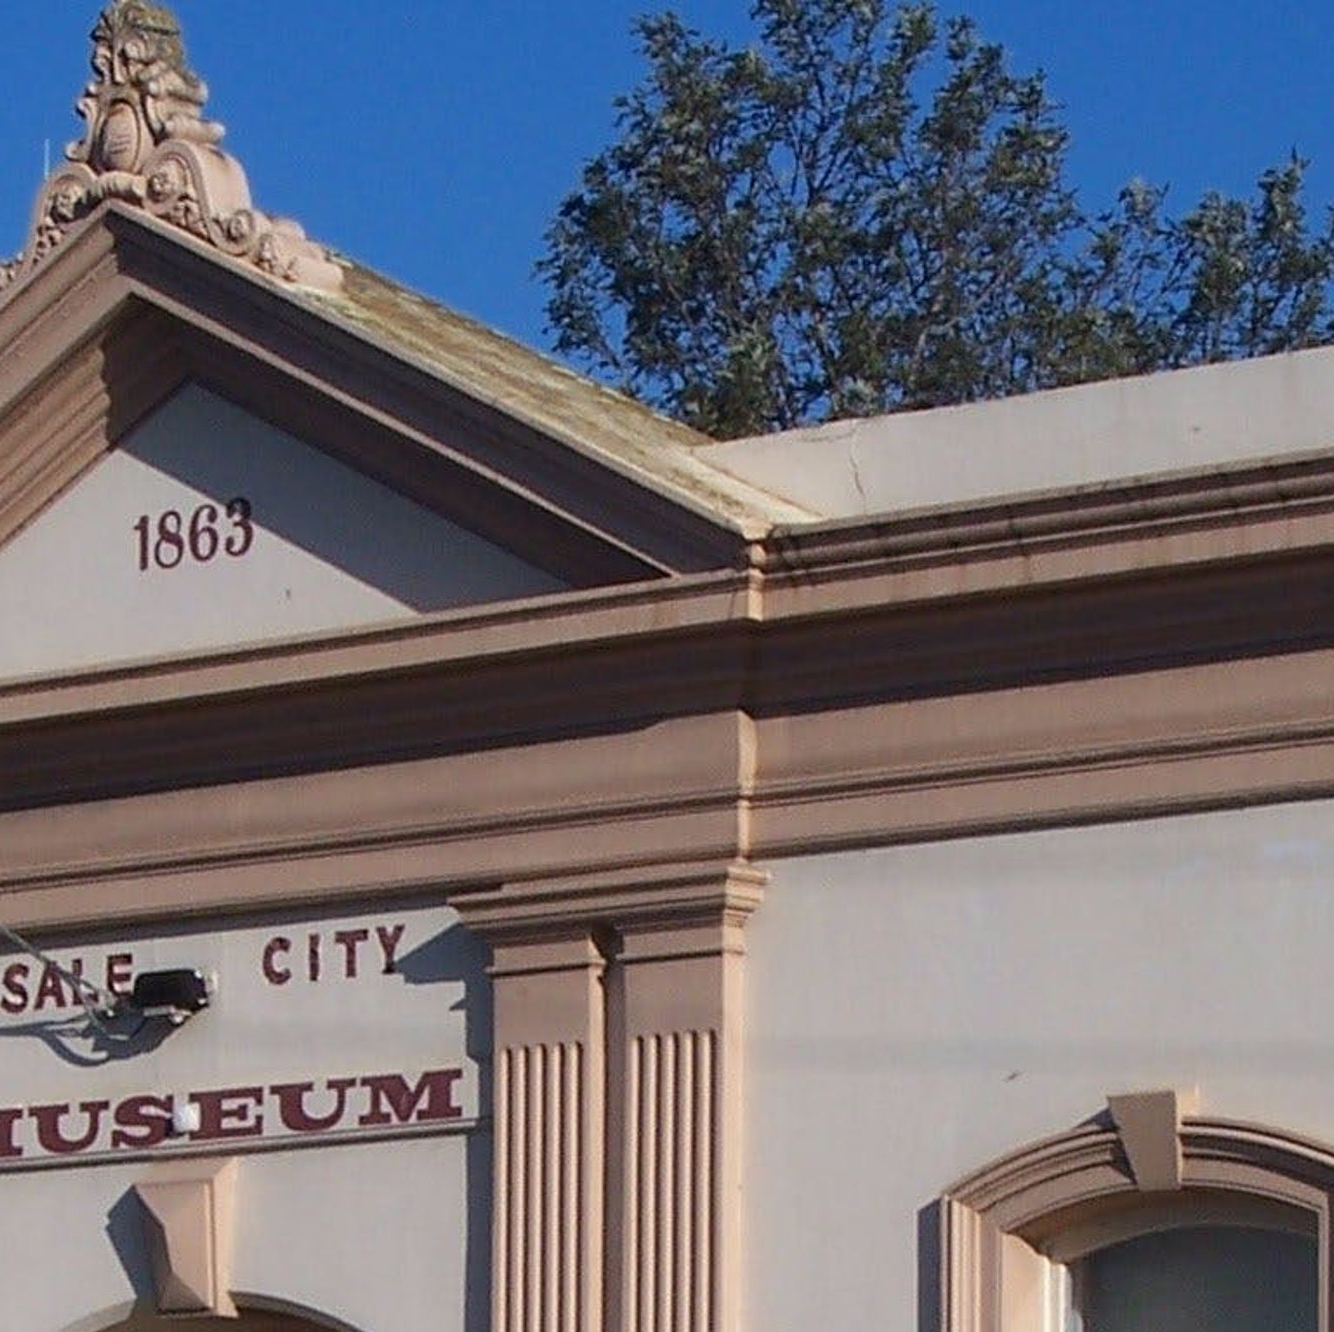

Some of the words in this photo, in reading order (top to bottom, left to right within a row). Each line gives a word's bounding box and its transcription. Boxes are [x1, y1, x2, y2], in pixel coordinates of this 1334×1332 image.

[134, 497, 254, 572] 1863
[0, 953, 133, 1015] SALE
[262, 924, 406, 985] CITY
